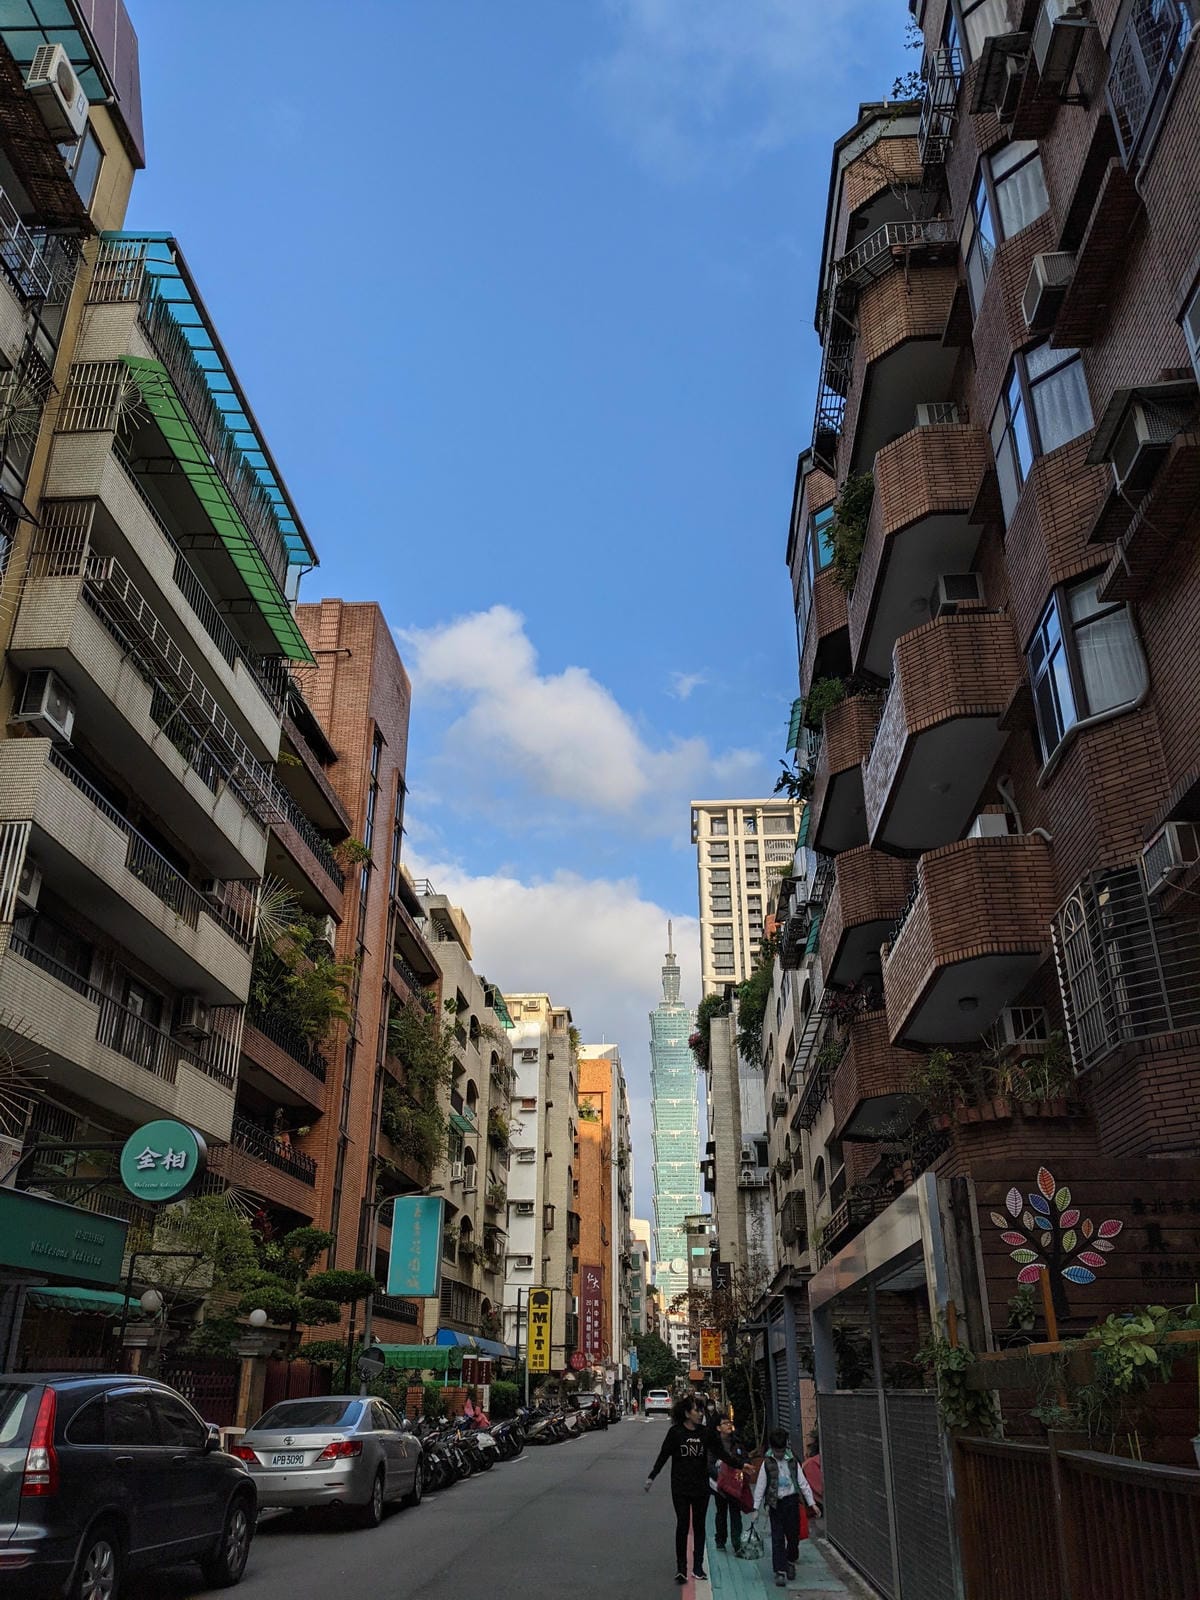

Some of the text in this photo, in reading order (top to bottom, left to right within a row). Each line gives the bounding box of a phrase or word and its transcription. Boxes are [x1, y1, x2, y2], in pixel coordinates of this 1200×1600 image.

[133, 1146, 187, 1170] 全相
[587, 1272, 600, 1289] 仁大
[716, 1266, 727, 1289] 仁大
[532, 1311, 548, 1351] MIT
